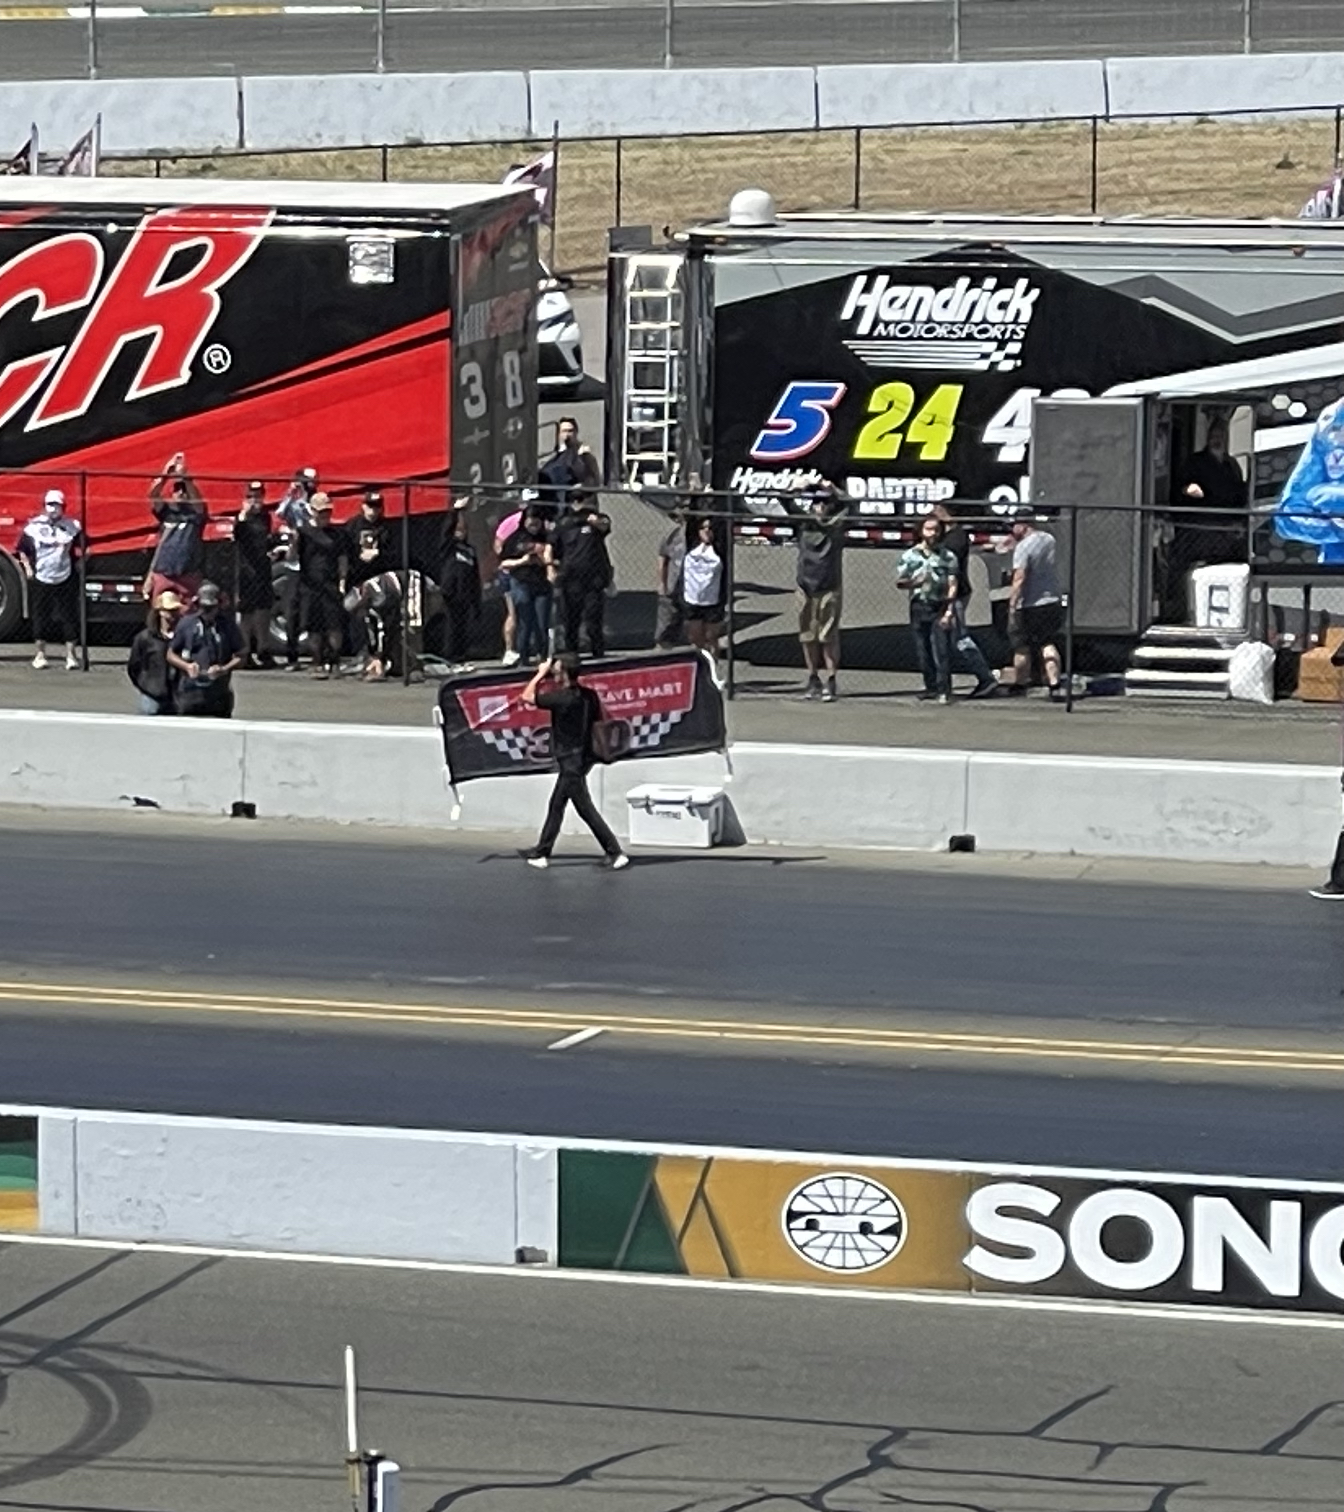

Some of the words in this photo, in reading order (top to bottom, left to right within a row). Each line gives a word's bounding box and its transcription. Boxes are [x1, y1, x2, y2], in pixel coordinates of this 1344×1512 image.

[840, 274, 1041, 335] Hendrick
[872, 322, 1028, 341] MOTORSPORTS
[460, 361, 488, 420] 3
[749, 381, 848, 462] 5
[852, 381, 964, 461] 24
